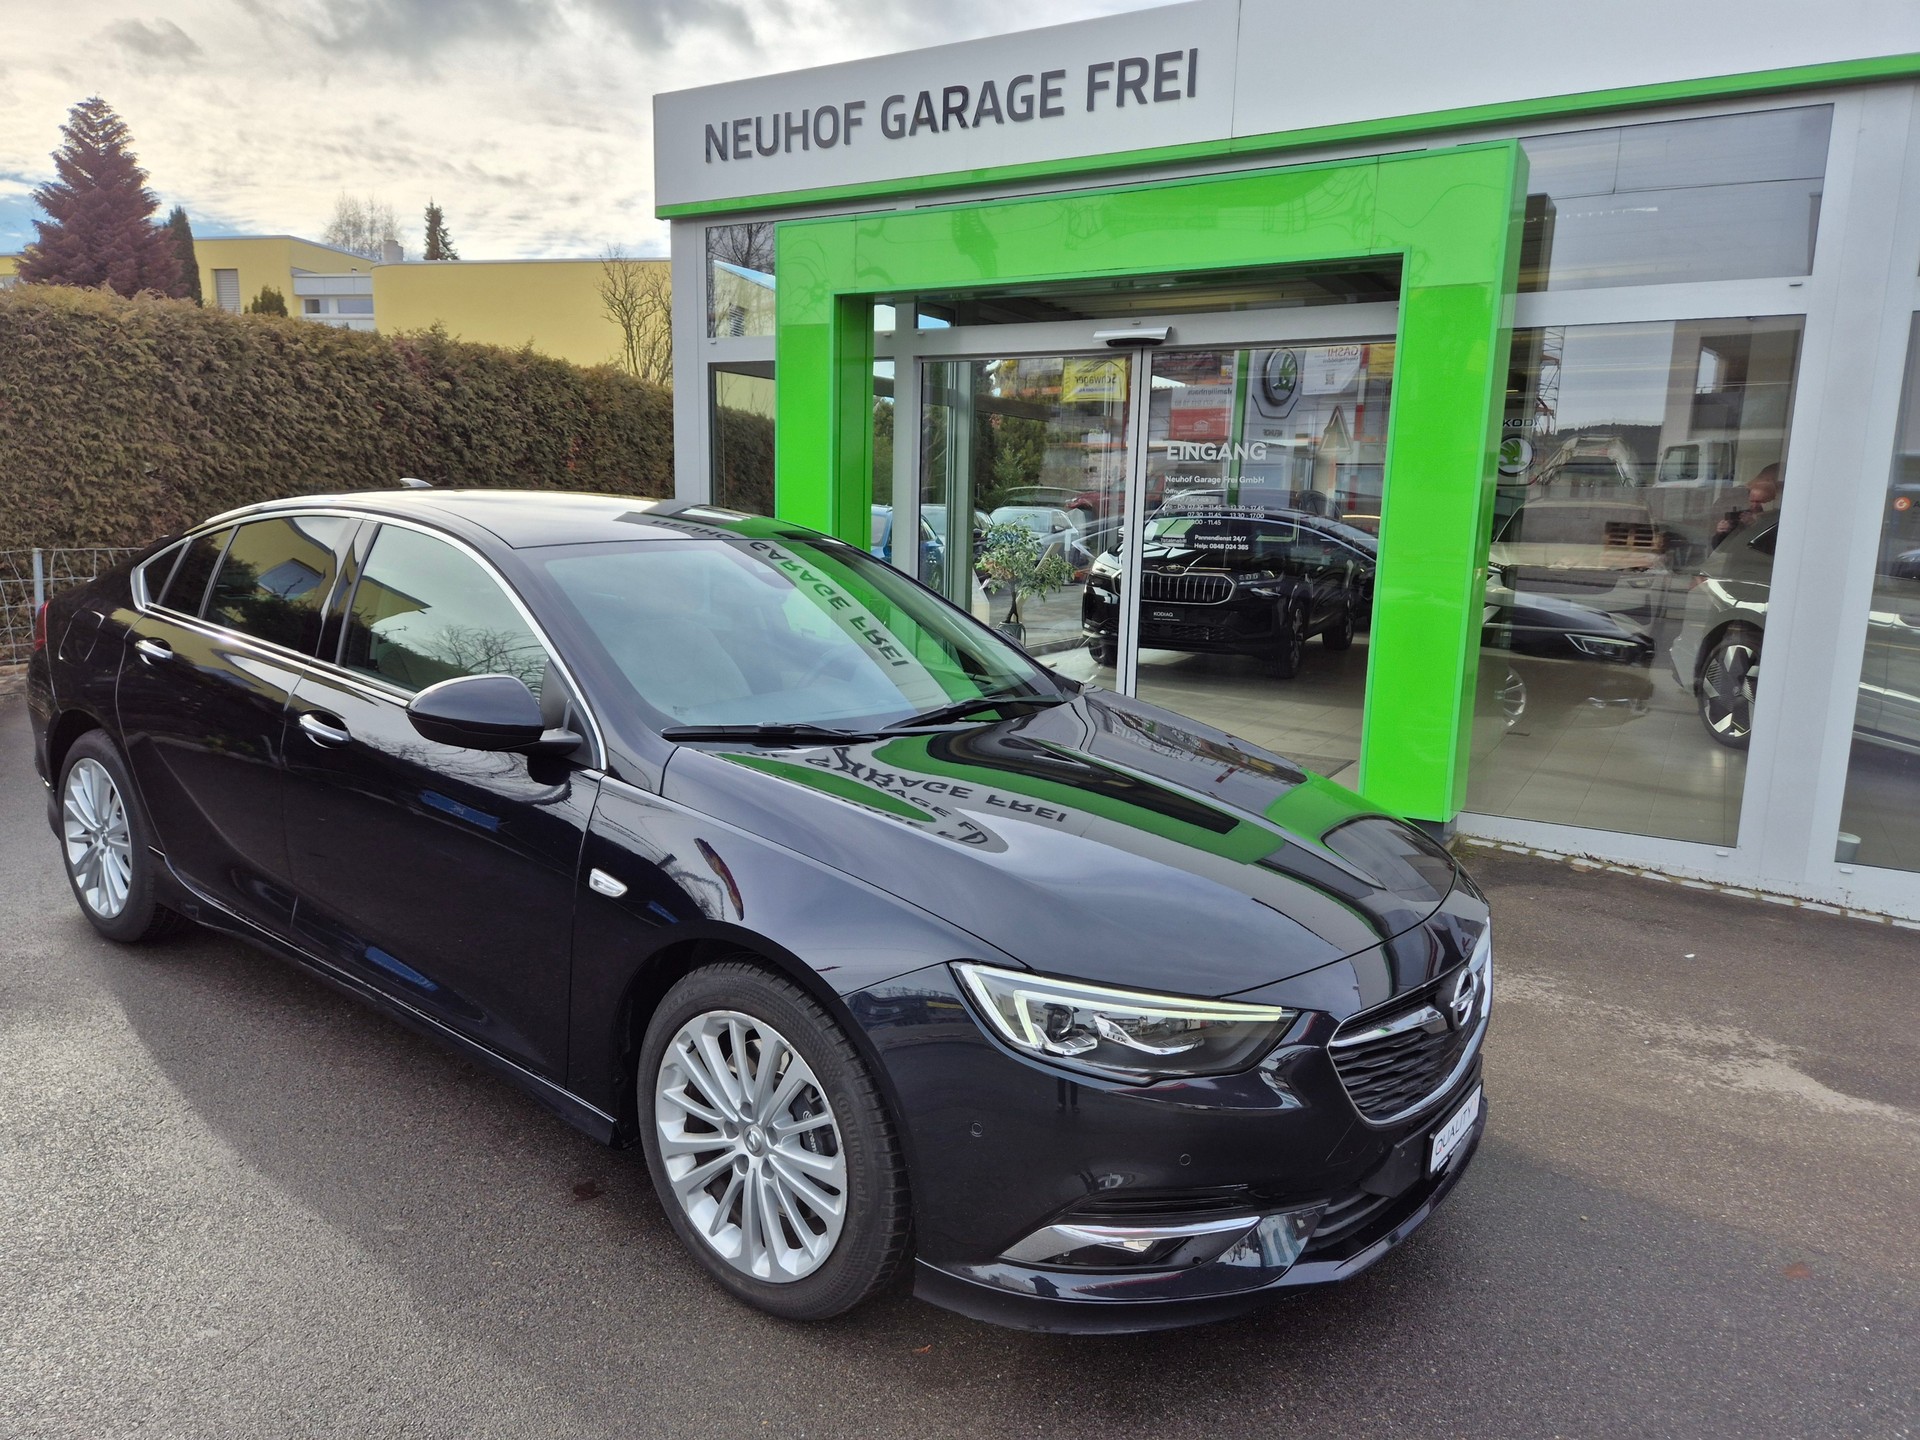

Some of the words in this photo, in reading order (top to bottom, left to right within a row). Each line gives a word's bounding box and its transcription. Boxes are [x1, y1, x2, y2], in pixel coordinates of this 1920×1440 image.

[705, 101, 866, 163] NEUHOF
[881, 69, 1066, 139] GARAGE
[1086, 48, 1198, 111] FREI
[1166, 442, 1267, 460] EINGANG
[1165, 475, 1192, 483] Neuhof
[1194, 476, 1221, 485] Garage
[1194, 542, 1208, 550] Help:
